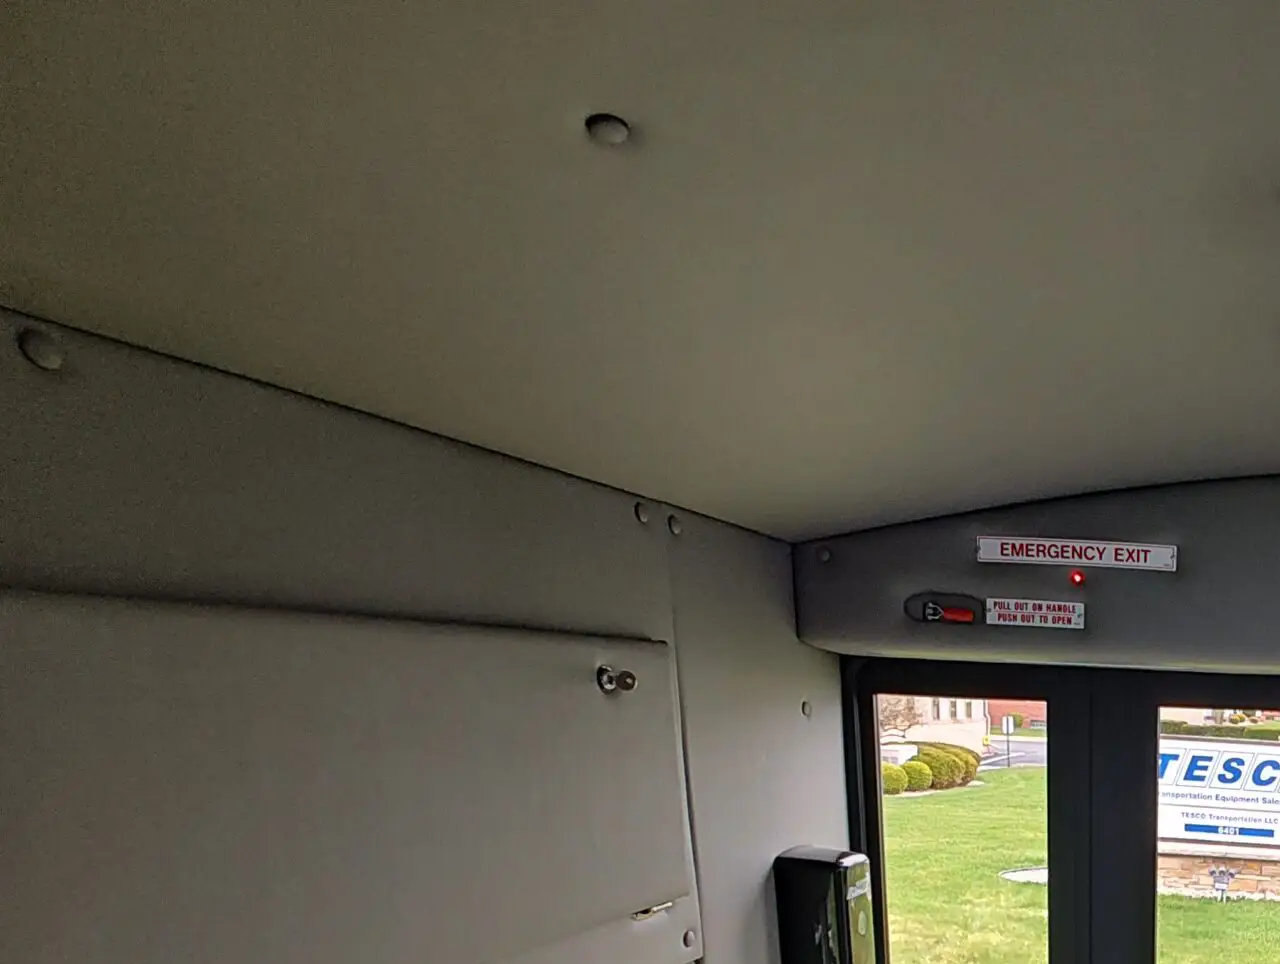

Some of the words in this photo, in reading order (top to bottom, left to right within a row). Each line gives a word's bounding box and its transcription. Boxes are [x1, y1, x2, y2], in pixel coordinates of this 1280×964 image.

[1000, 542, 1106, 561] EMERGENCY
[1114, 547, 1151, 563] EXIT
[993, 601, 1011, 610] PULL
[1014, 601, 1028, 610] OUT
[1032, 602, 1043, 611] ON
[1046, 603, 1076, 614] HANDLE
[997, 613, 1018, 622] PUSH
[1020, 614, 1035, 623] OUT
[1039, 615, 1048, 624] TO
[1052, 616, 1073, 625] OPEN
[1215, 794, 1260, 804] Equipment
[1181, 811, 1207, 820] TESCO
[1208, 813, 1263, 824] Transportation
[1264, 817, 1279, 825] LLC
